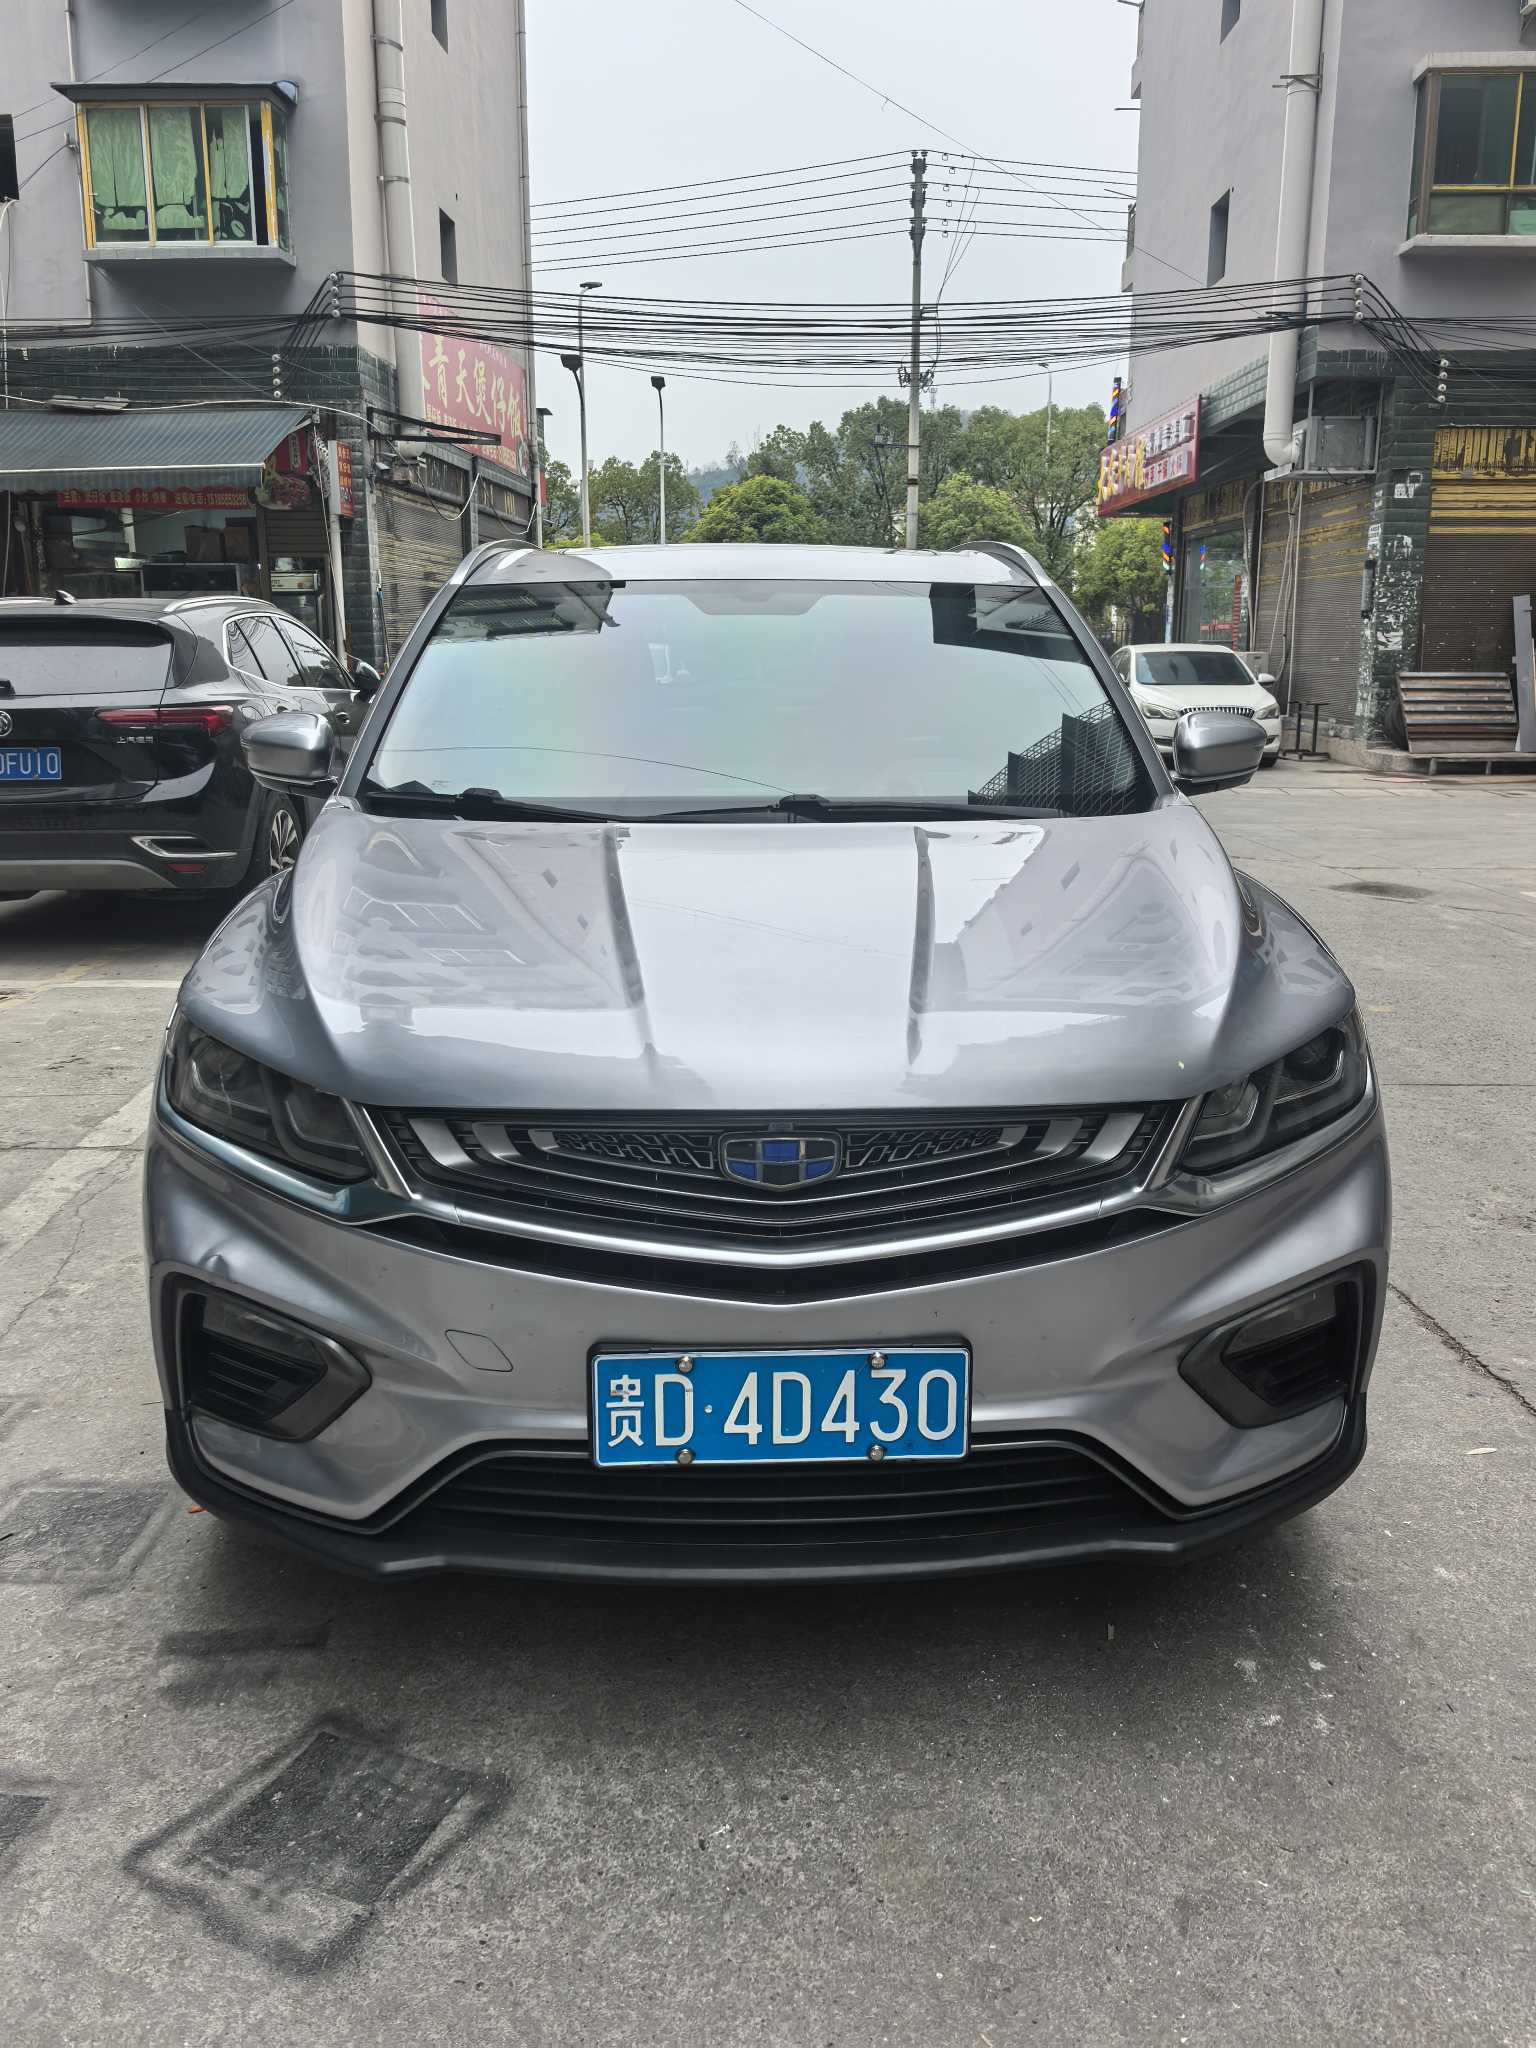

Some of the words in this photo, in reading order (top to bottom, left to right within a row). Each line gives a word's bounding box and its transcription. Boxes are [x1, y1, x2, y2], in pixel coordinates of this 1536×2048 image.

[422, 335, 525, 444] 青天煲仔饭
